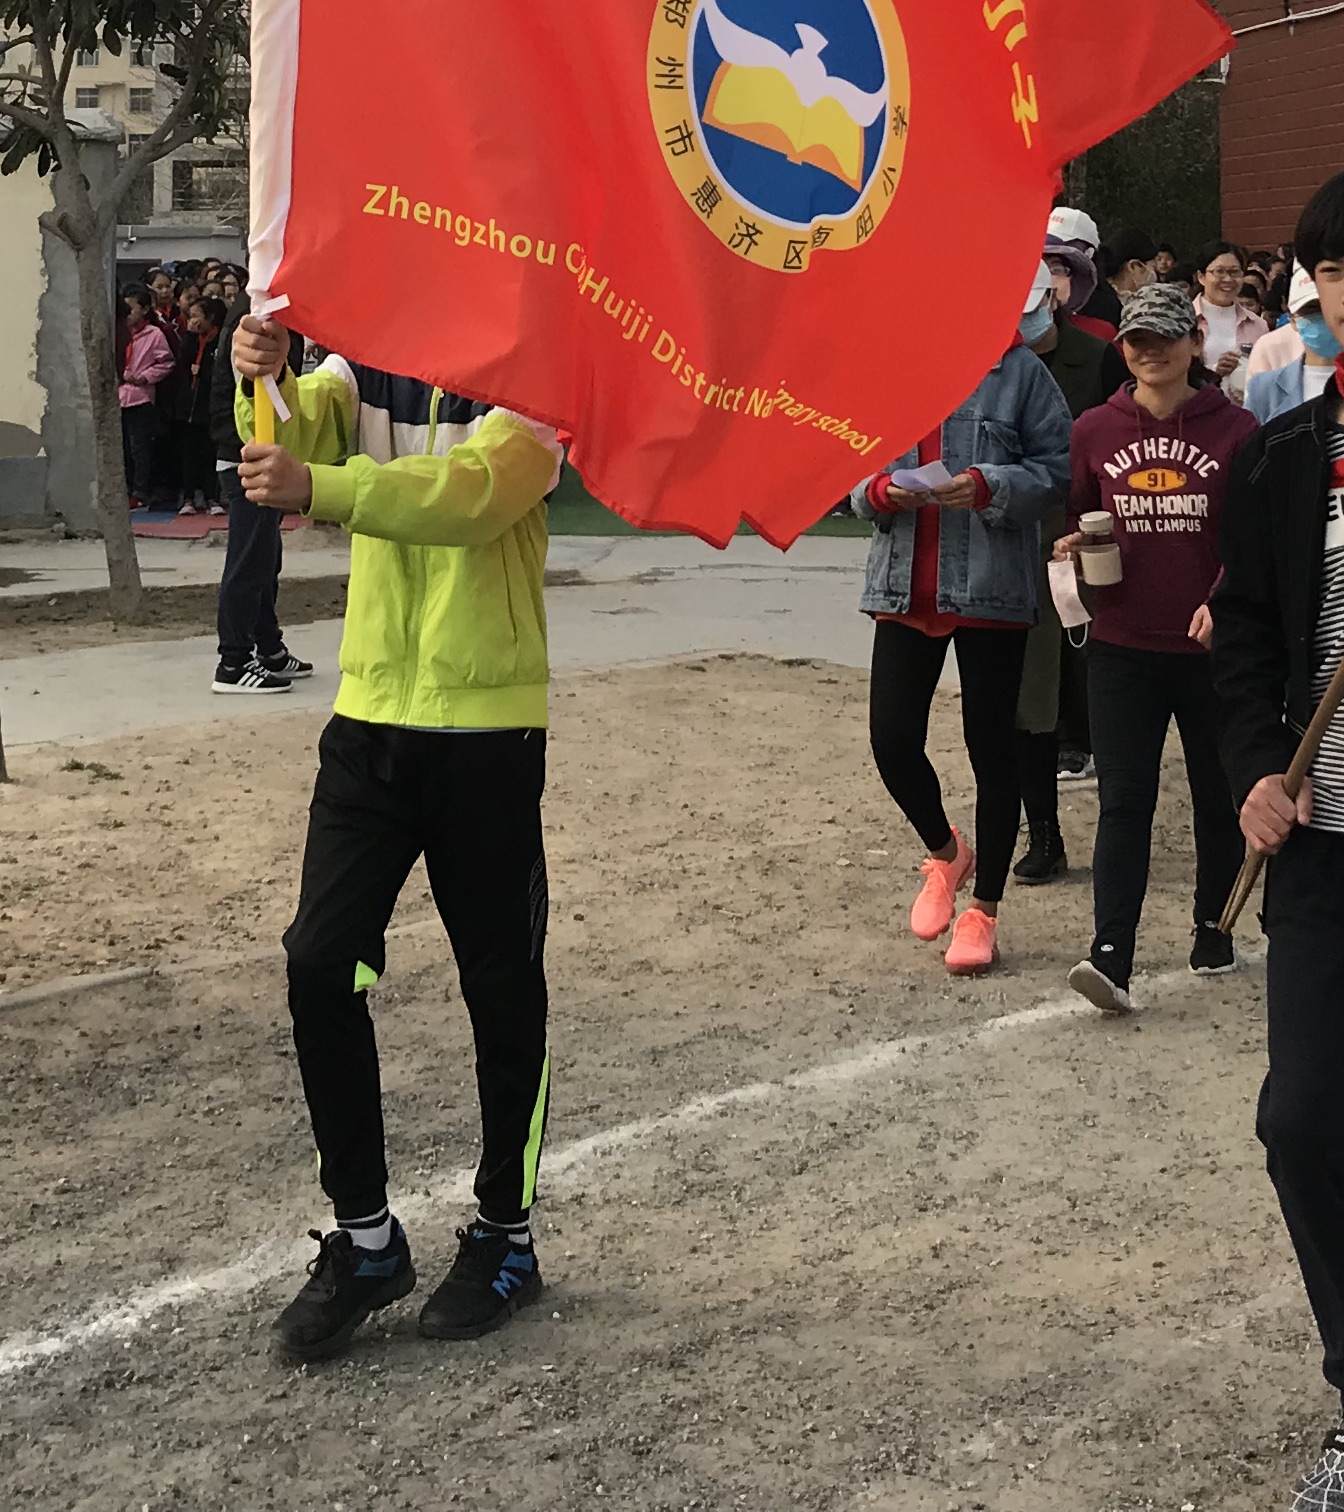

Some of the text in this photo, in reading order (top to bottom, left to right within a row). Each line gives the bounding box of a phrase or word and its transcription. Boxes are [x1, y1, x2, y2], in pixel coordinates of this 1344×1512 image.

[362, 183, 556, 266] Zhengzhou
[578, 267, 654, 343] Huiji
[651, 329, 746, 412] District
[812, 414, 883, 456] school
[1103, 436, 1220, 479] AUTHENTIC
[1147, 472, 1166, 487] 91
[1112, 493, 1208, 518] TEAM HONOR
[1125, 518, 1202, 533] ANTA CAMPUS
